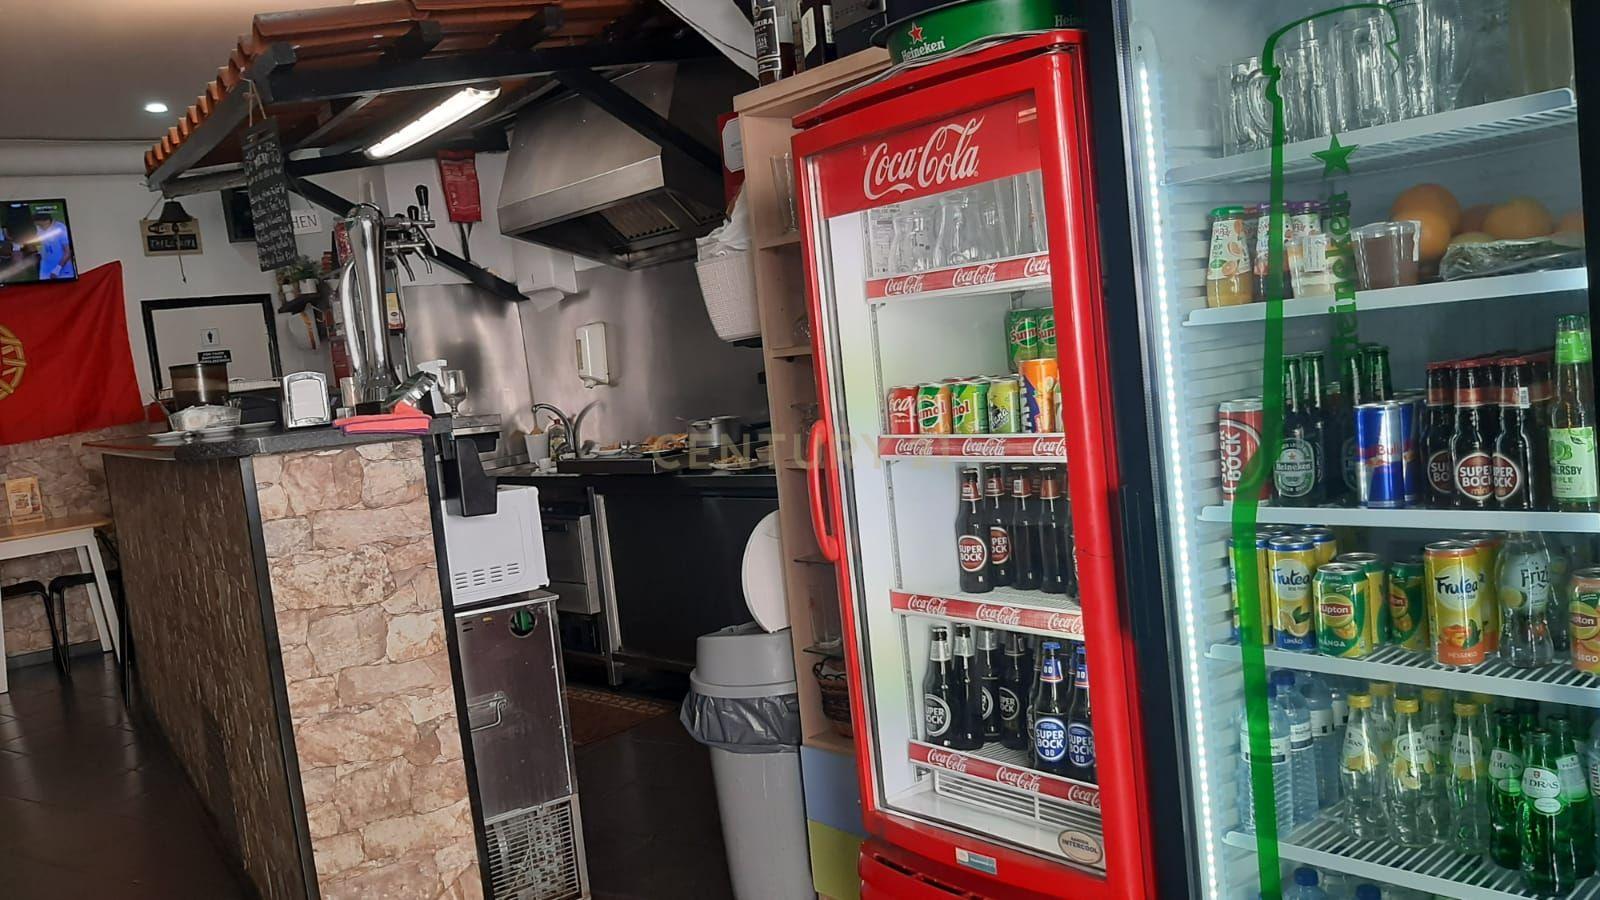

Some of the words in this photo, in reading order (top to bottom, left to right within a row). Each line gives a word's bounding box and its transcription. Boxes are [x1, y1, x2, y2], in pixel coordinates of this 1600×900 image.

[901, 38, 946, 62] Heineken
[864, 115, 984, 200] Coca-Cola
[885, 275, 924, 297] Coca-Cola
[952, 264, 998, 288] Coca-Cola
[1225, 432, 1242, 482] BOCK
[1321, 604, 1349, 614] Lipton
[1035, 728, 1065, 740] SUPER
[1037, 738, 1064, 749] BOCK
[1061, 838, 1098, 854] INTERCOOL
